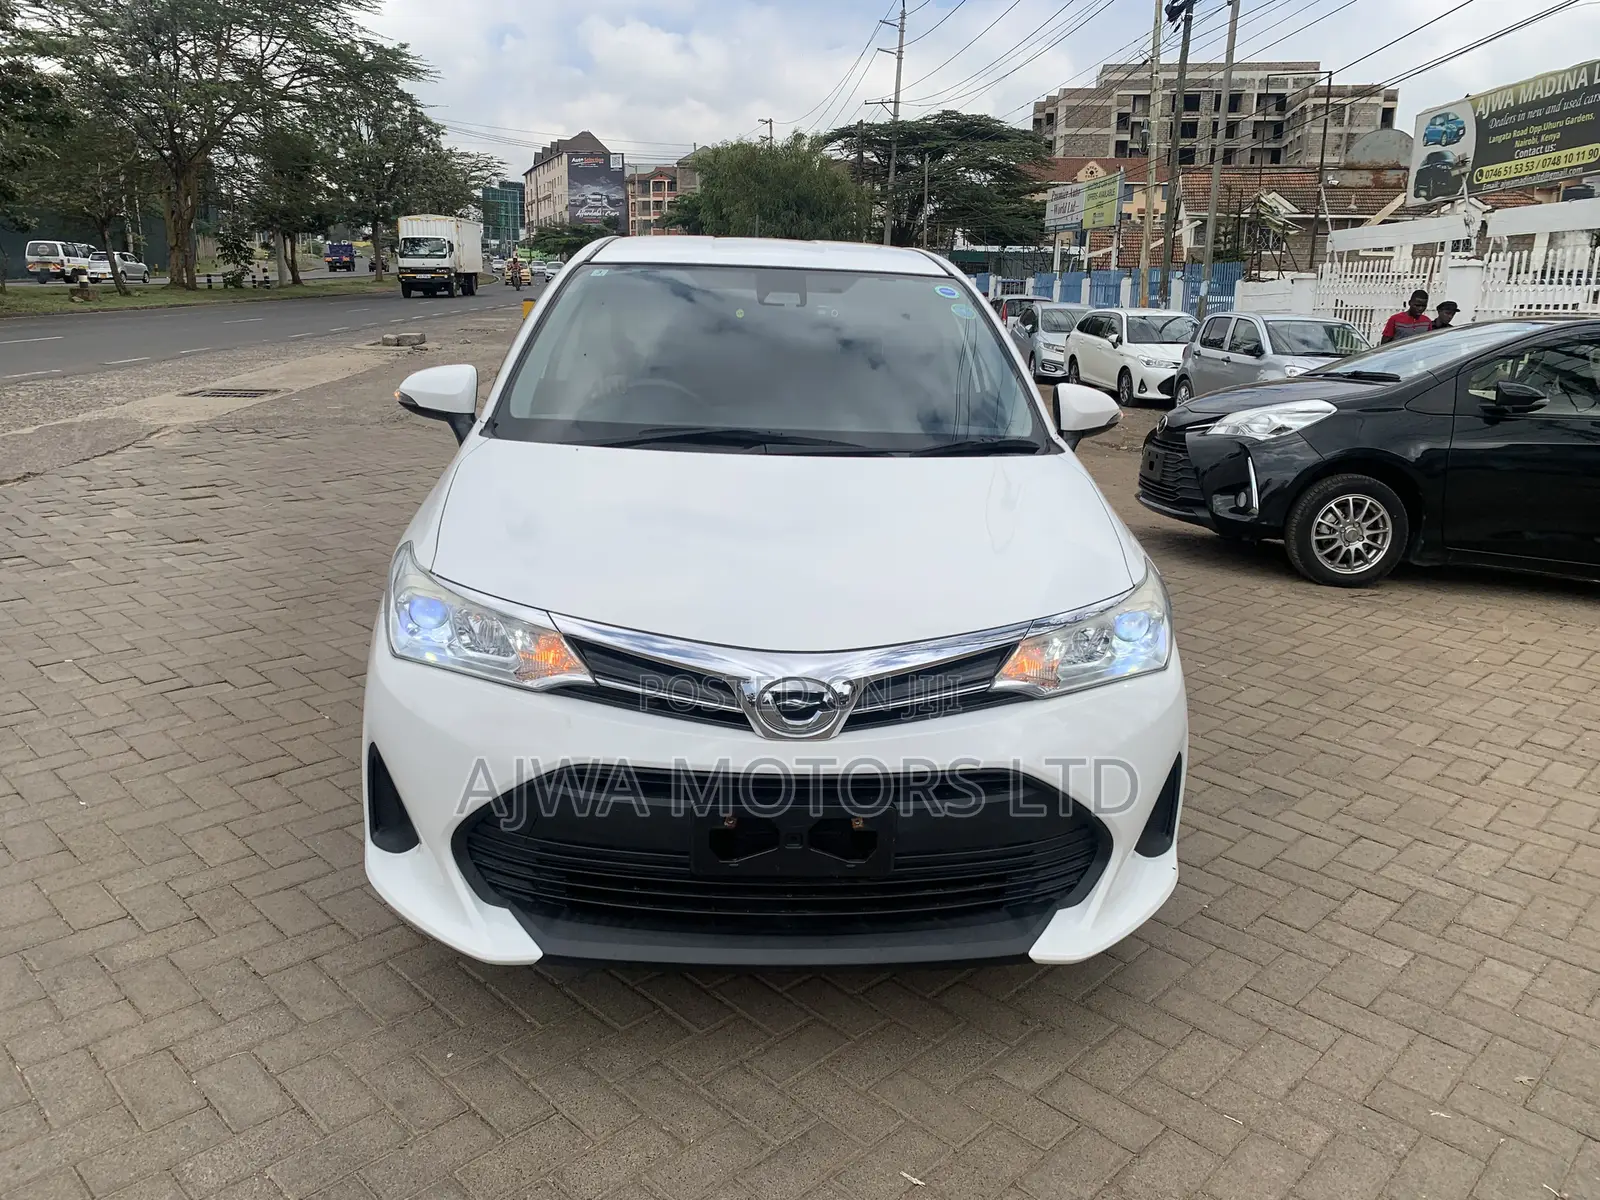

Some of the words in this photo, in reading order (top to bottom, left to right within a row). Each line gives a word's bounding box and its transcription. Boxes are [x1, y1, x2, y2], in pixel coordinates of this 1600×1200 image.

[1475, 88, 1514, 119] AJWA
[1519, 67, 1588, 104] MADINA
[1489, 112, 1517, 129] Dealers
[1518, 110, 1526, 121] in
[1527, 107, 1545, 118] new
[1545, 97, 1564, 115] and
[1563, 92, 1586, 110] used
[1489, 131, 1512, 144] Langata
[1512, 126, 1528, 138] Road
[1541, 131, 1561, 144] Kenya
[1484, 168, 1501, 179] 0746
[1503, 166, 1512, 176] 51
[1513, 163, 1523, 174] 53
[1525, 161, 1535, 172] 53
[1541, 156, 1561, 169] 0748
[1564, 153, 1574, 164] 10
[1576, 150, 1586, 161] 11
[1588, 147, 1600, 160] 90
[1514, 145, 1543, 159] Contact
[1544, 143, 1557, 153] us:
